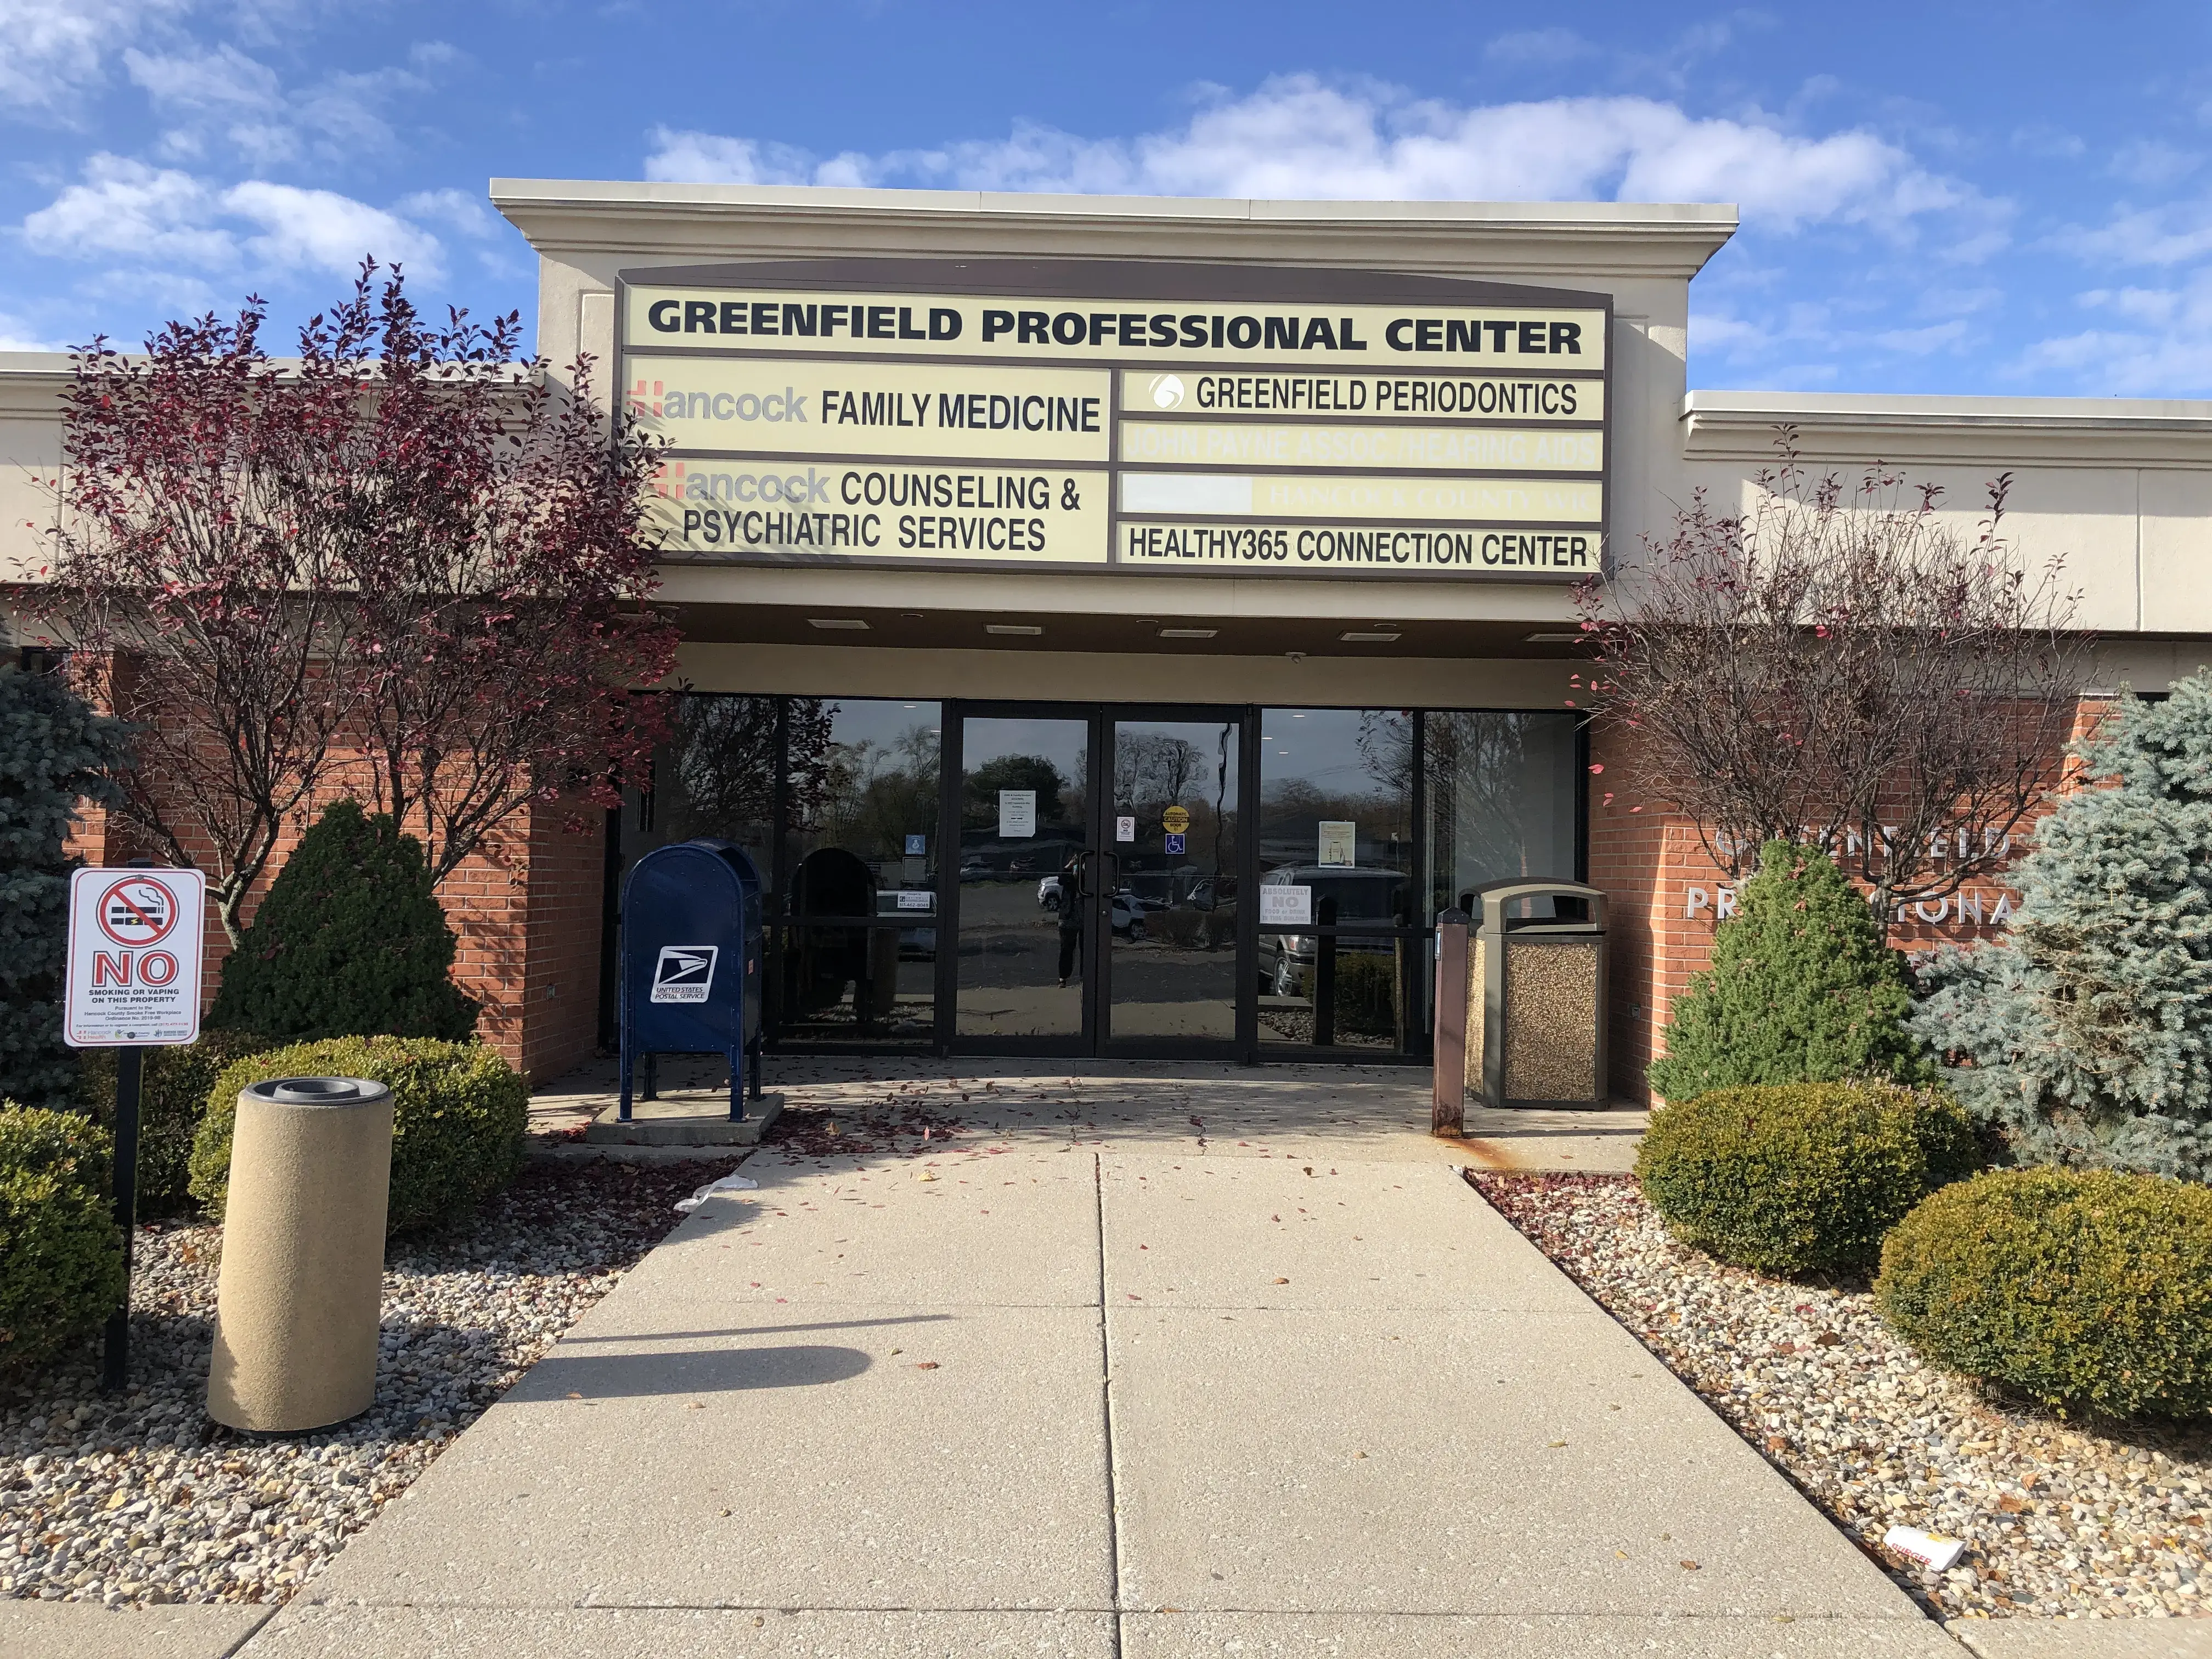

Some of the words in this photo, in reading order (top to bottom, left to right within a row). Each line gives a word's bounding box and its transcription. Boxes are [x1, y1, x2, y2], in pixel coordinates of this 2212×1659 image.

[648, 299, 962, 341] GREENFIELD
[982, 309, 1367, 351] PROFESSIONAL
[1385, 318, 1582, 354] CENTER
[627, 380, 808, 423] Hancock
[822, 390, 932, 427] FAMILY
[939, 393, 1100, 432] MEDICINE
[1197, 377, 1366, 410] GREENFIELD
[1377, 381, 1577, 414] PERIODONTICS
[1126, 427, 1198, 457] JOHN
[1206, 429, 1289, 460] PAYNE
[1534, 436, 1596, 465] AIDS
[841, 472, 1050, 510] COUNSELING
[1060, 478, 1081, 511] &
[683, 510, 881, 548] PSYCHIATRIC
[899, 515, 1046, 552] SERVICES
[1128, 528, 1288, 560] HEALTHY365
[1297, 530, 1472, 564] CONNECTION
[1482, 534, 1587, 566] CENTER
[1272, 896, 1299, 908] NO
[92, 950, 179, 988] NO
[1891, 1542, 1932, 1565] BURGER
